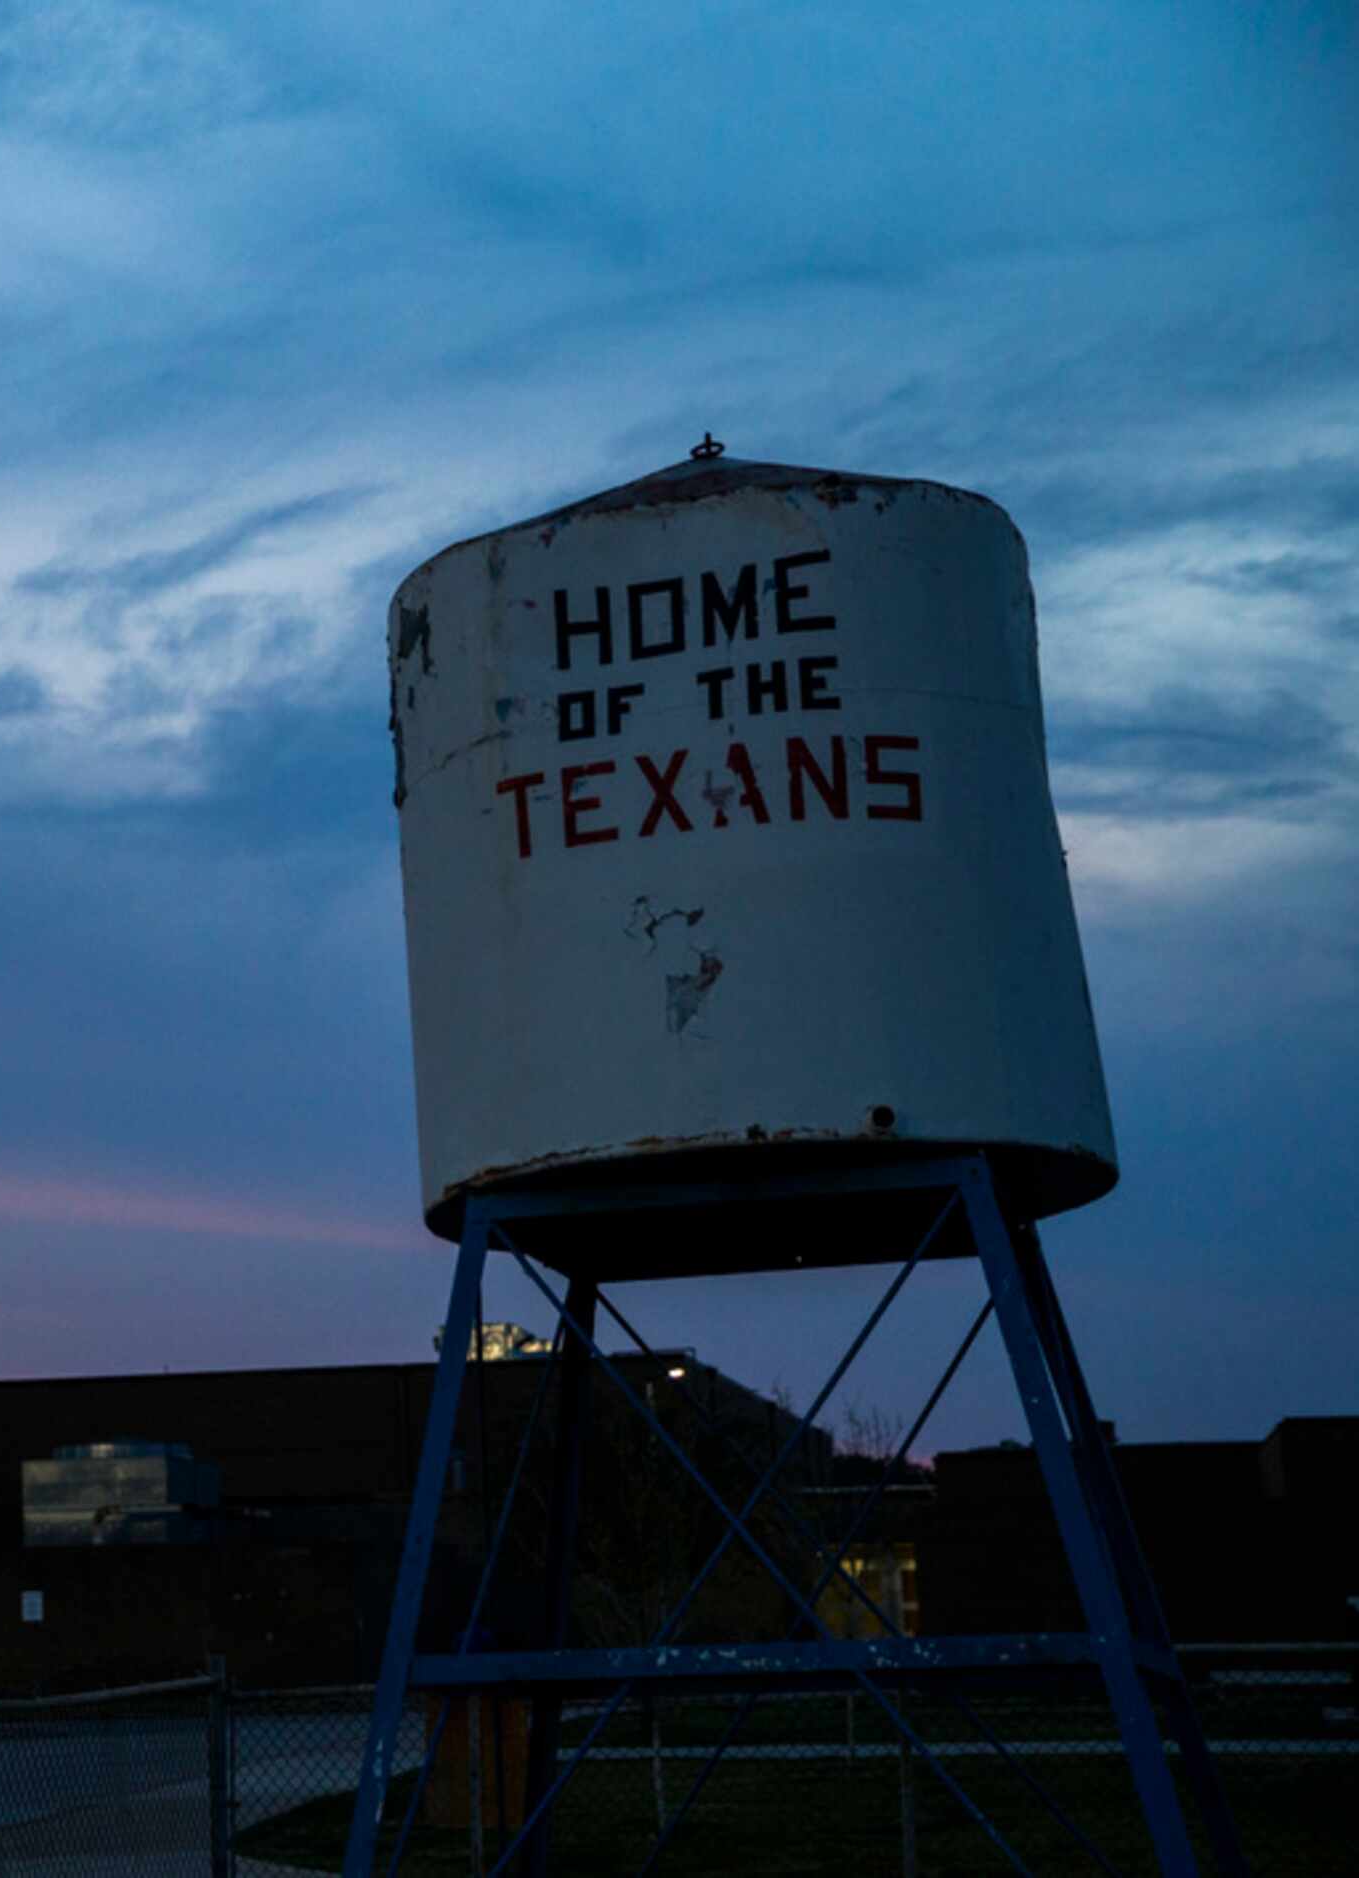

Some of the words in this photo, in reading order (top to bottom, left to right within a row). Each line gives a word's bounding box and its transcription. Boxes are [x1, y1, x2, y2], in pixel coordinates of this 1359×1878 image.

[554, 549, 835, 669] HOME
[558, 684, 644, 741] OF
[697, 656, 840, 719] THE
[497, 736, 922, 857] TEXANS
